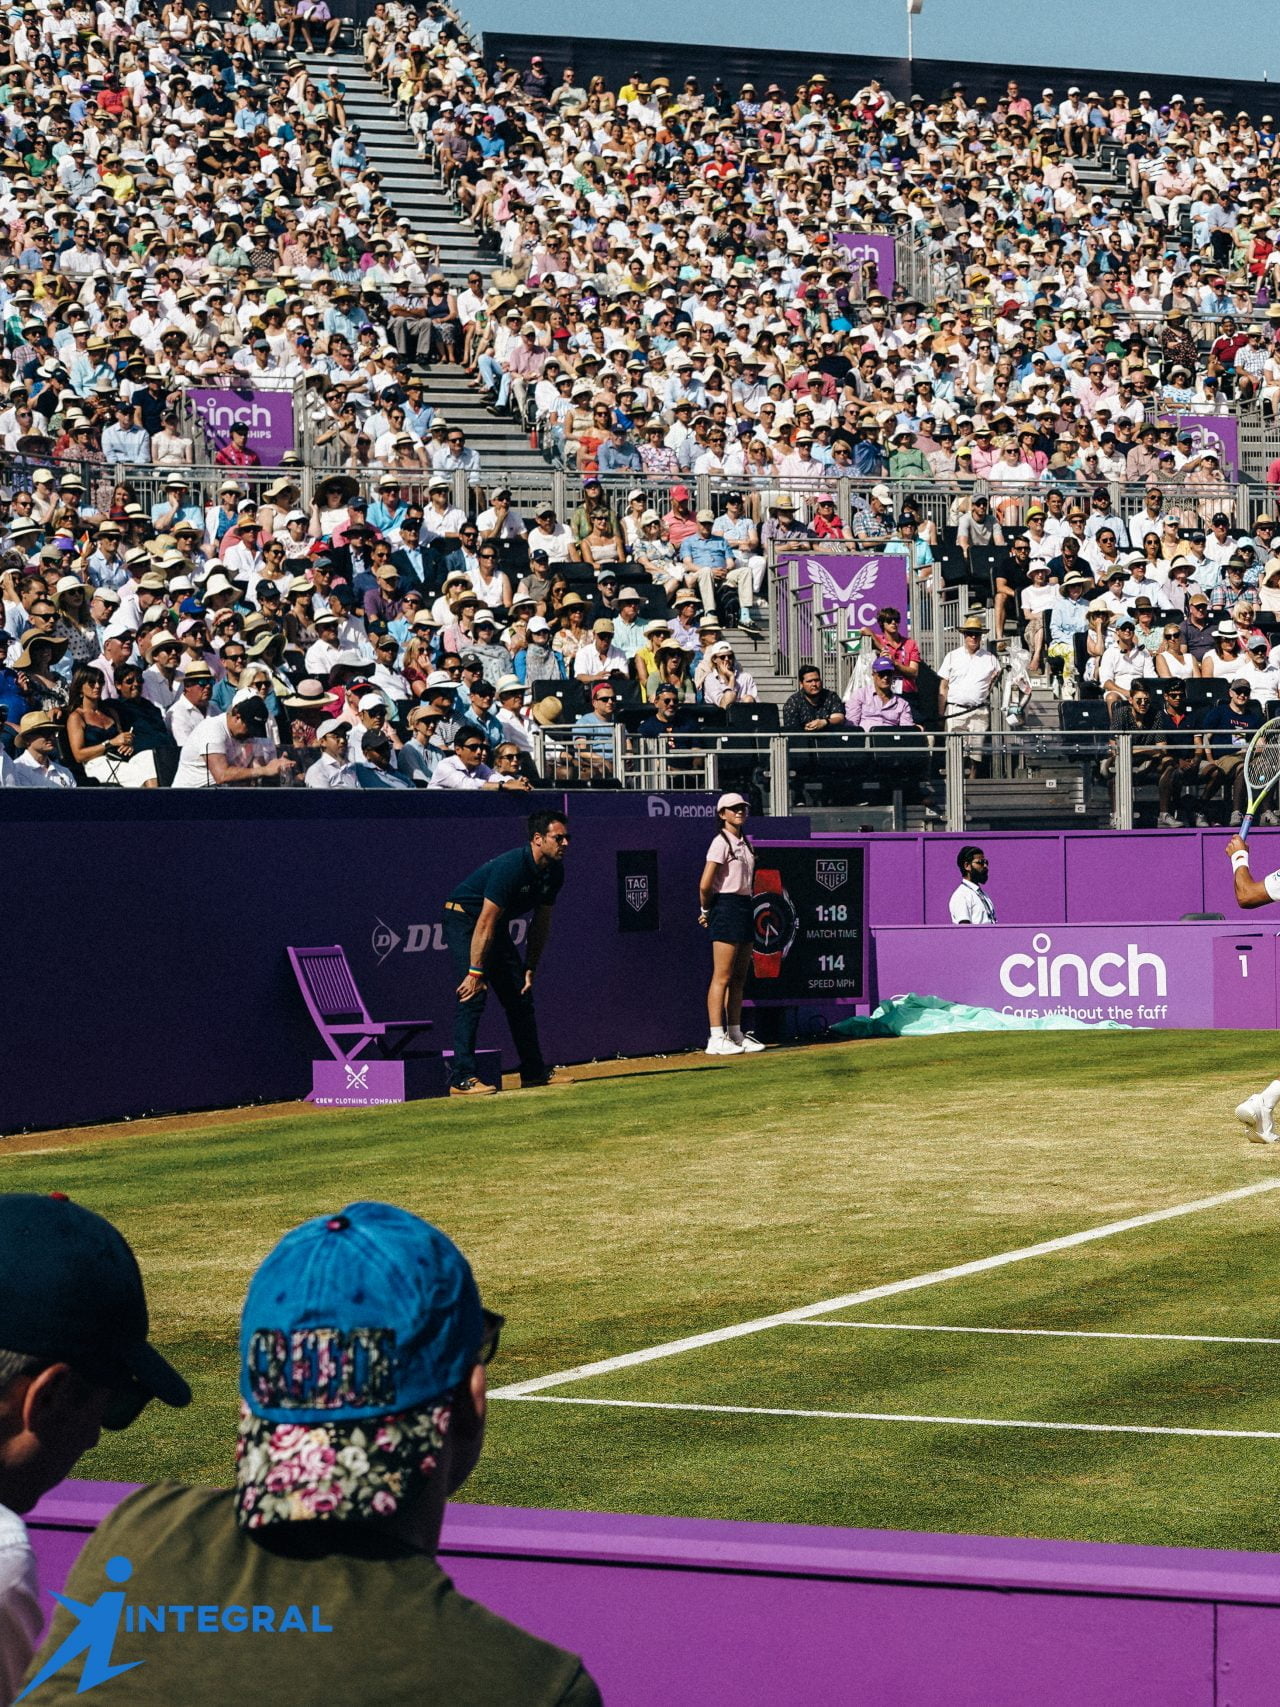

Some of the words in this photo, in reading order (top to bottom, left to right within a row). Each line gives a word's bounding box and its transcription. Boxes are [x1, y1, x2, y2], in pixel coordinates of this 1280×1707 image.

[819, 861, 845, 872] TAG
[627, 878, 647, 889] TAG
[818, 873, 846, 888] HEUER
[627, 890, 647, 908] HEUER
[815, 904, 848, 922] 1:18
[806, 929, 837, 939] MATCH
[838, 929, 858, 939] TIME
[817, 954, 846, 971] 114
[999, 932, 1168, 998] cinch
[1238, 954, 1248, 978] 1
[808, 979, 835, 989] SPEED
[836, 978, 855, 988] MPH
[1001, 1005, 1039, 1019] Cars
[1043, 1005, 1104, 1020] without
[1107, 1005, 1133, 1020] the
[1137, 1004, 1168, 1020] faff
[335, 1097, 368, 1105] CLOTHING
